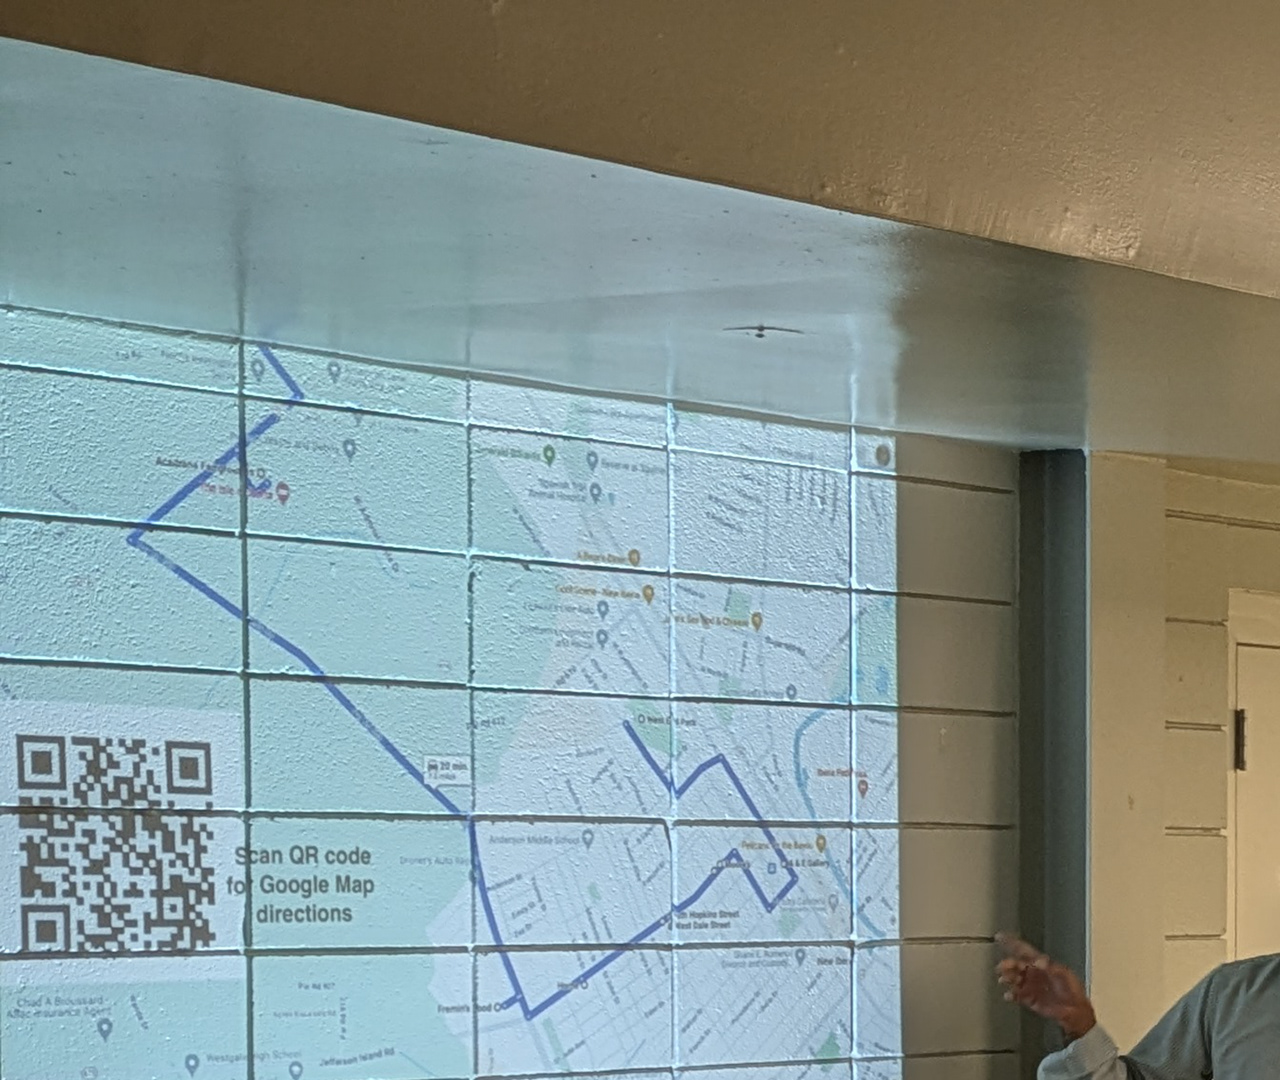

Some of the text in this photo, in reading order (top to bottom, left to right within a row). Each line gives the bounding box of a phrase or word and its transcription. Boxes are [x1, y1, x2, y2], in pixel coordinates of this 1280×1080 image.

[527, 834, 553, 845] Middle
[554, 834, 580, 845] School
[235, 845, 372, 868] Scan QR code
[259, 874, 329, 899] Google
[335, 874, 375, 898] Map
[256, 904, 353, 924] directions
